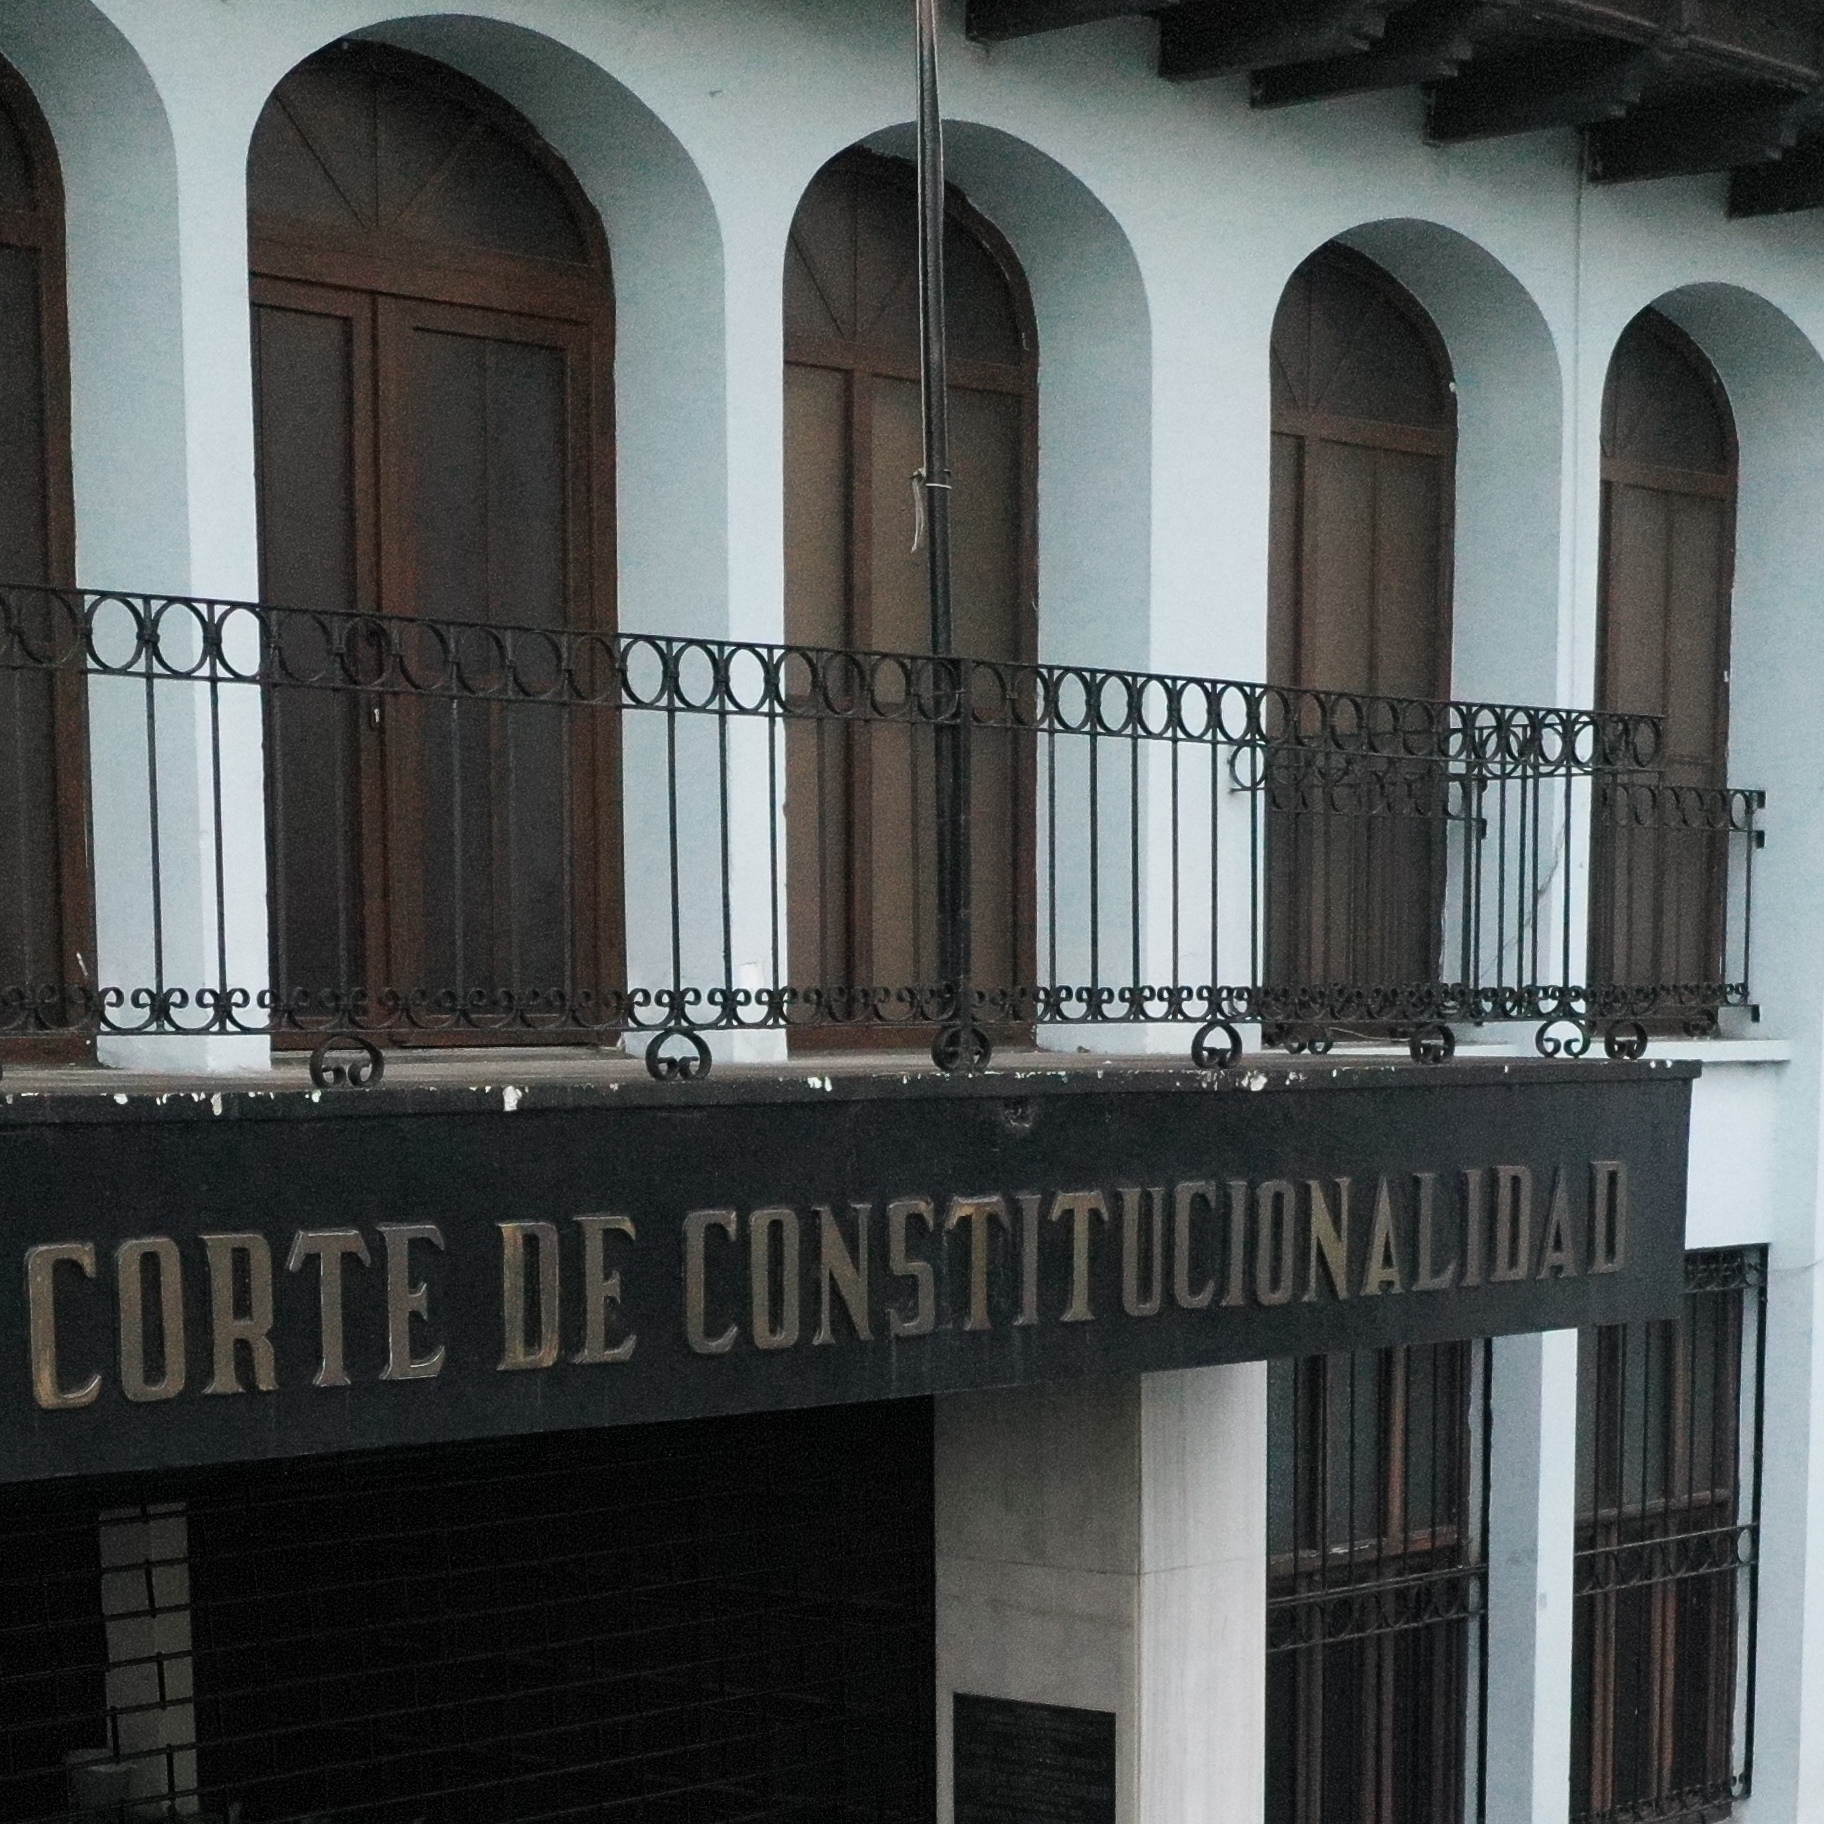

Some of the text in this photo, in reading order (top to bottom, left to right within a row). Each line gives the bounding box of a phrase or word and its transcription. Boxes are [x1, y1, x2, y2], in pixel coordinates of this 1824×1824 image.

[24, 1159, 1628, 1409] CORTE DE CONSTITUCIONALIDAD
